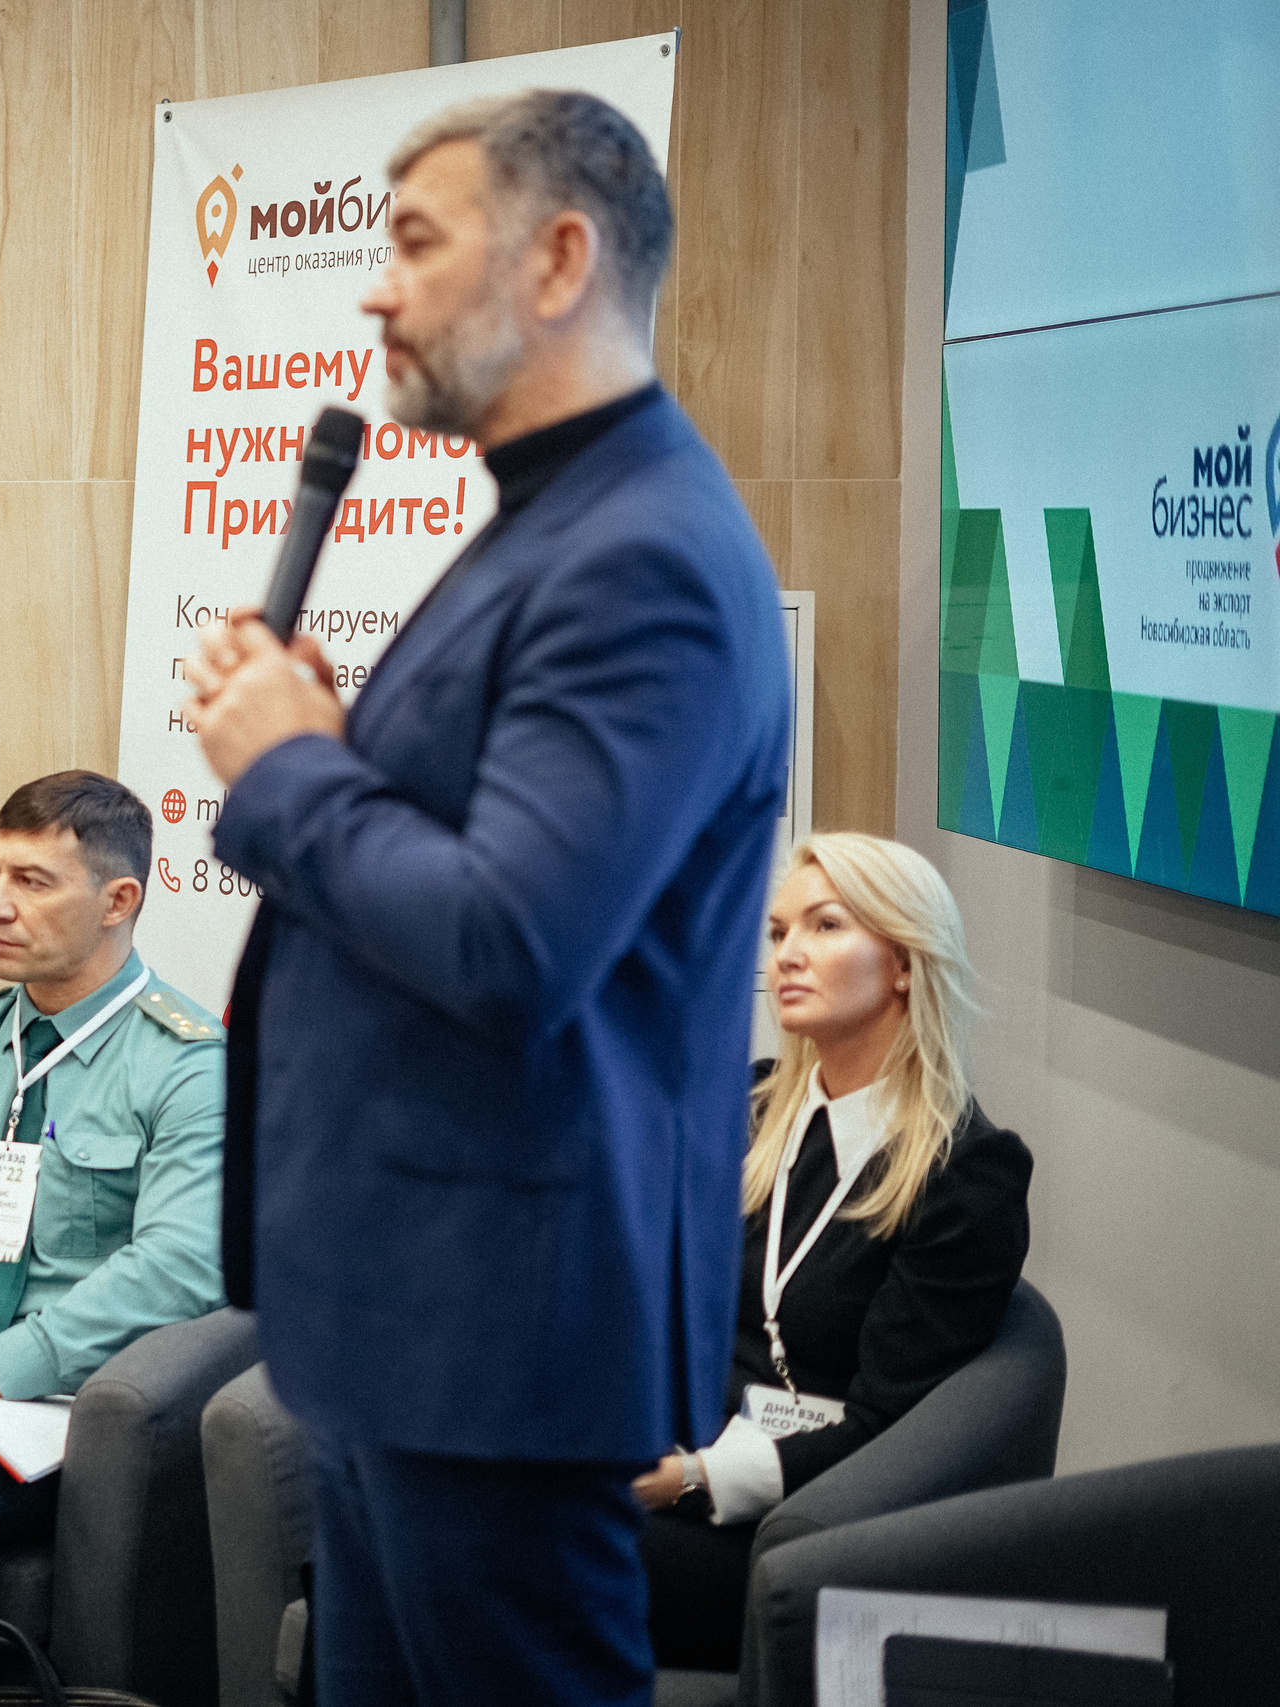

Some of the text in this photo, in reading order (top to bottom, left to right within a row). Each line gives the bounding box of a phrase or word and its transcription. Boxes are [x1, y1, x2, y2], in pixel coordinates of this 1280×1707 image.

[249, 174, 398, 241] мойби
[248, 254, 291, 278] центр
[294, 248, 363, 271] оказания
[192, 338, 374, 402] Вашему
[186, 421, 485, 478] нужн омо
[1192, 424, 1253, 488] мой
[183, 476, 466, 550] Прихдите!
[1151, 474, 1253, 539] бизнес
[1185, 559, 1251, 586] продвижение
[176, 594, 399, 643] Контируем
[1198, 592, 1251, 620] на экспорт
[1140, 614, 1251, 650] Новосибирская область
[192, 858, 208, 893] 8
[8, 1153, 26, 1165] ВЭД
[763, 1401, 826, 1424] ДНИ ВЭД
